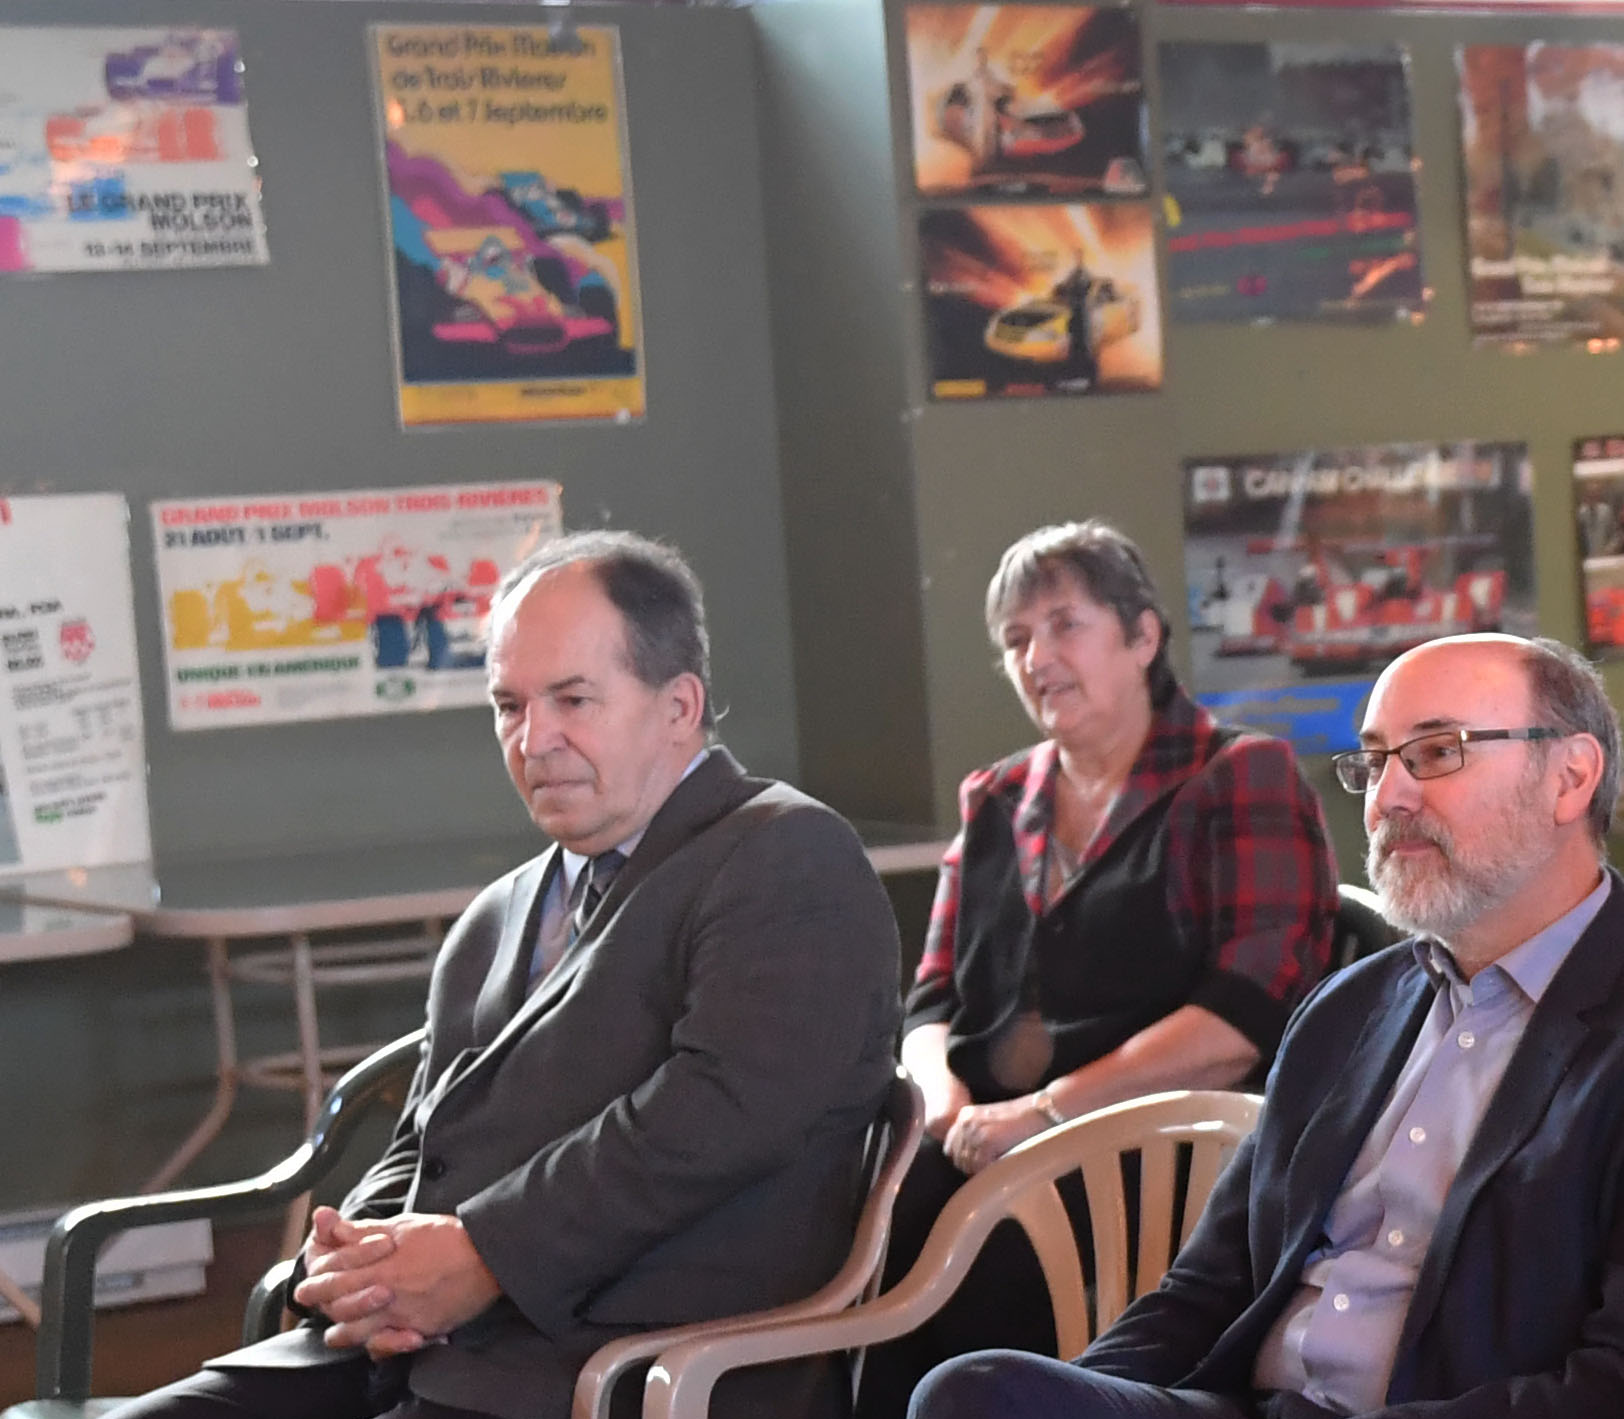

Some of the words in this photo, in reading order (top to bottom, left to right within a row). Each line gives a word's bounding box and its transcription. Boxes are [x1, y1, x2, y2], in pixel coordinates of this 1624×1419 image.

[388, 34, 458, 57] Grand
[465, 33, 504, 55] Prix
[101, 192, 186, 212] GRAND
[193, 192, 248, 210] PRIX
[150, 213, 253, 230] MOLSON
[161, 506, 240, 526] GRAND
